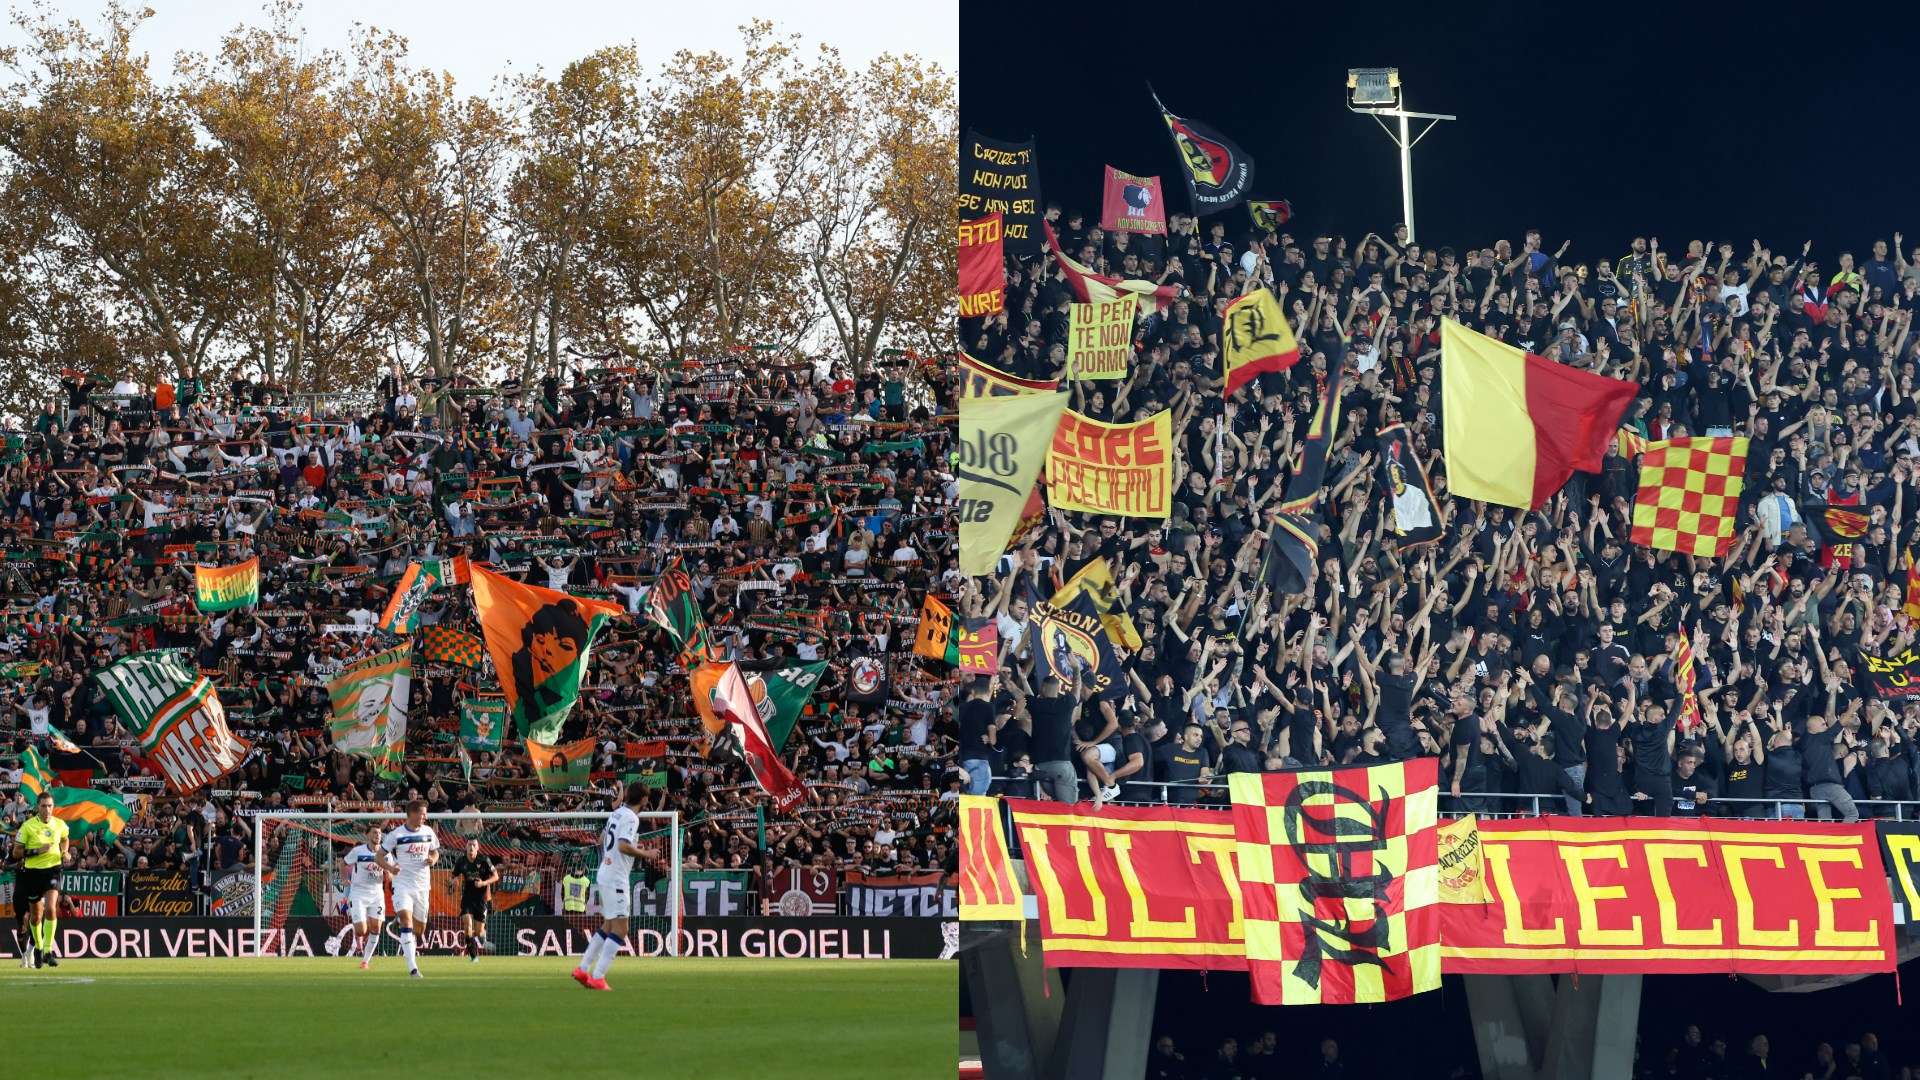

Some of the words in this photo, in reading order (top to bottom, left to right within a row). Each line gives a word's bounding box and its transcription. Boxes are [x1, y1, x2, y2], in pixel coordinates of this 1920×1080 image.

[1012, 199, 1036, 215] SEI
[959, 290, 1003, 316] NIRE
[1076, 303, 1094, 325] IO
[1100, 300, 1132, 323] PER
[1076, 327, 1095, 349] TE
[1099, 323, 1130, 347] NON
[1074, 349, 1128, 374] DORMO
[1052, 411, 1164, 466] CORE
[1833, 544, 1853, 558] ZE
[60, 876, 114, 894] VENTISEI
[553, 879, 744, 917] GATE
[1021, 826, 1245, 940] ULT
[1482, 842, 1880, 948] LECCE
[160, 928, 315, 958] VENEZIA
[739, 928, 891, 960] GIOIELLI
